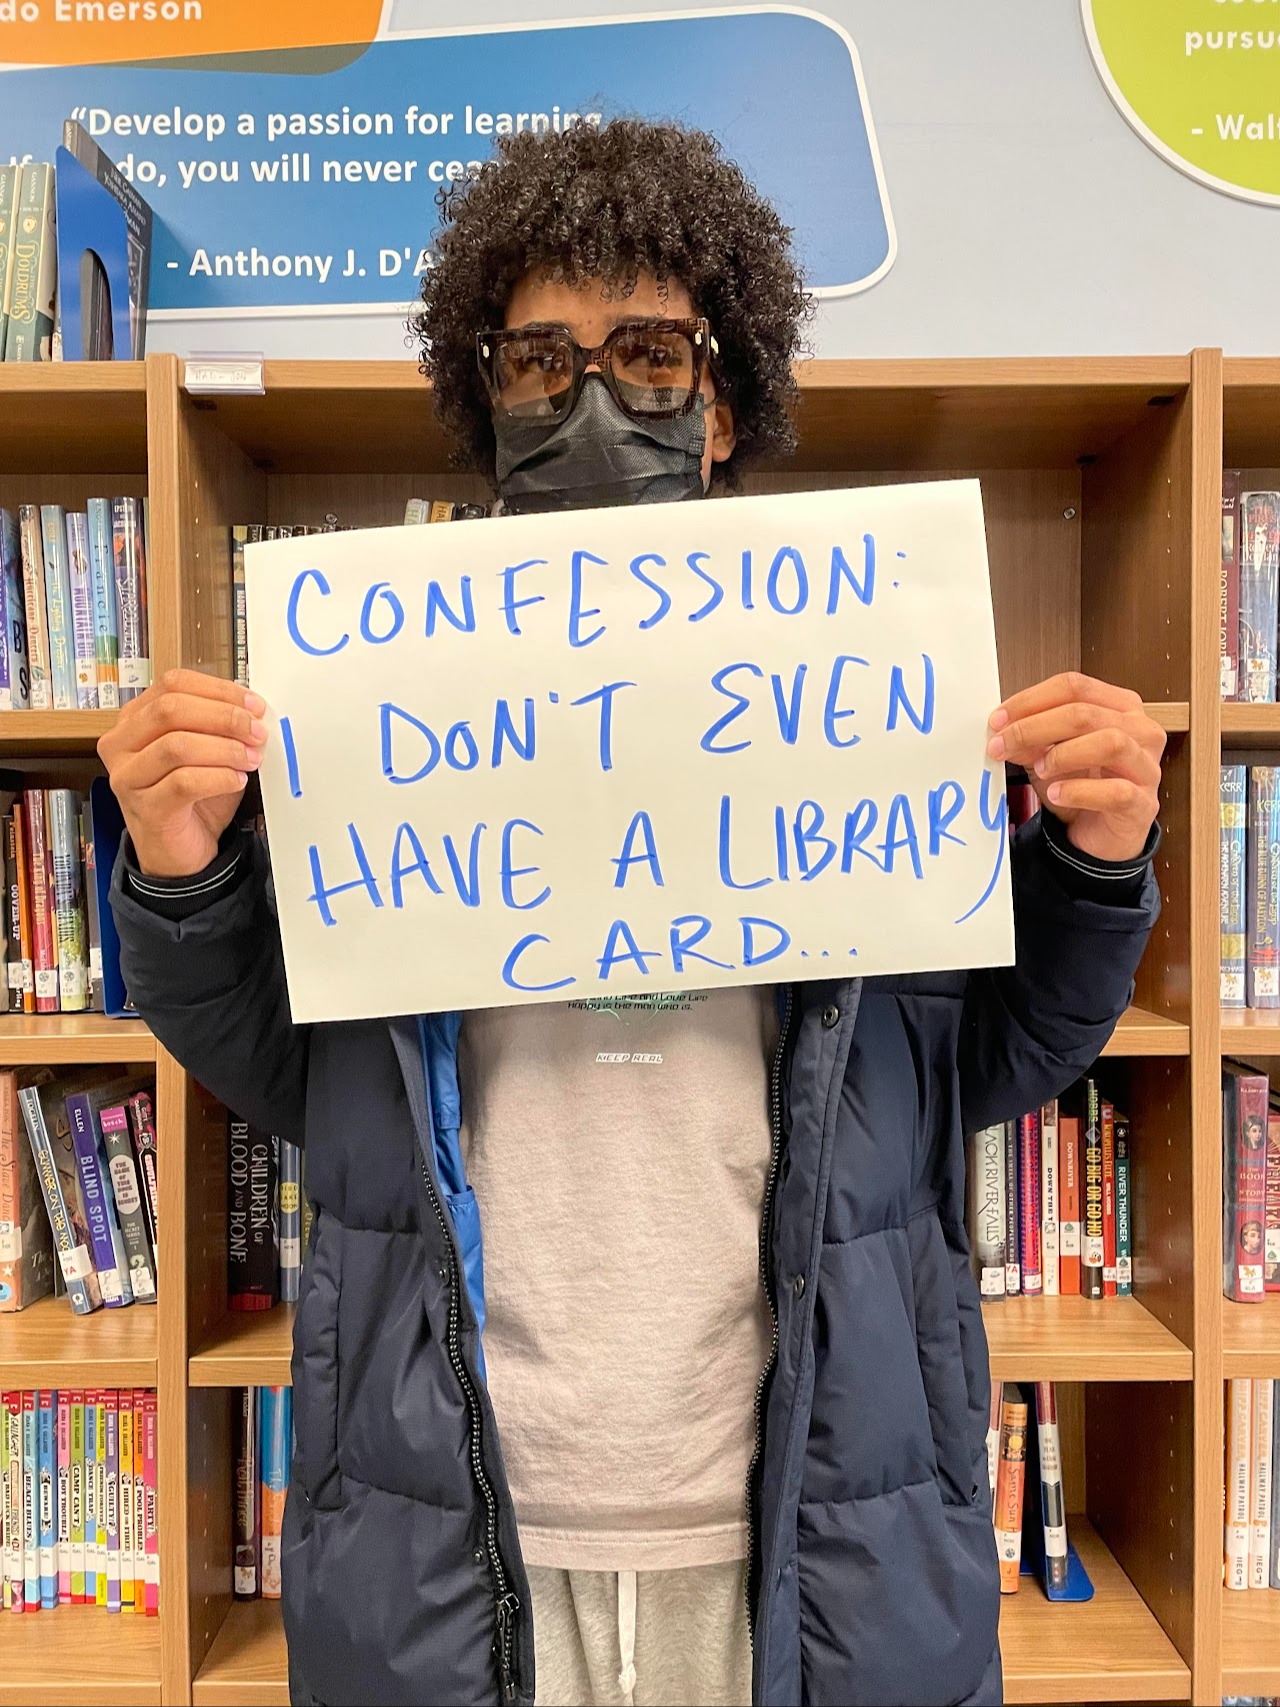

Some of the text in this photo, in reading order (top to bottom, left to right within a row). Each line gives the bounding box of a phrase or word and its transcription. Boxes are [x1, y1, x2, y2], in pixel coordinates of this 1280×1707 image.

[55, 0, 203, 22] Emerson
[1185, 31, 1280, 57] pursu
[236, 113, 255, 135] a
[267, 105, 394, 141] passion
[404, 105, 454, 135] for
[177, 159, 239, 189] you
[250, 152, 310, 182] will
[323, 159, 418, 183] never
[188, 247, 333, 283] Anthony
[342, 249, 366, 276] J.
[287, 533, 908, 656] CONFESSION:
[278, 653, 935, 798] I DON'T EVEN
[306, 770, 1009, 927] HAVE A LIBRARY
[11, 884, 21, 940] COVER-UP
[34, 896, 46, 925] Dragons
[502, 915, 859, 991] CARD...
[596, 1053, 664, 1064] KEEP REAL
[74, 1108, 85, 1133] ELLEN
[1089, 1089, 1098, 1123] HOBBS
[0, 1154, 16, 1189] Slave
[230, 1122, 248, 1186] BLOOD
[2, 1193, 14, 1221] Danc
[80, 1155, 107, 1242] BLIND SPOT
[249, 1143, 270, 1244] CHILDREN OF
[978, 1128, 1000, 1242] LACK RIVER FALLS
[1086, 1147, 1102, 1237] GO BIG OR GO HO
[1118, 1166, 1127, 1242] RIVER THUNDER
[230, 1211, 249, 1263] BONE
[1007, 1468, 1021, 1523] Same Sun
[1237, 1464, 1246, 1520] HALLWAY PATROL
[1258, 1494, 1266, 1519] PATROL
